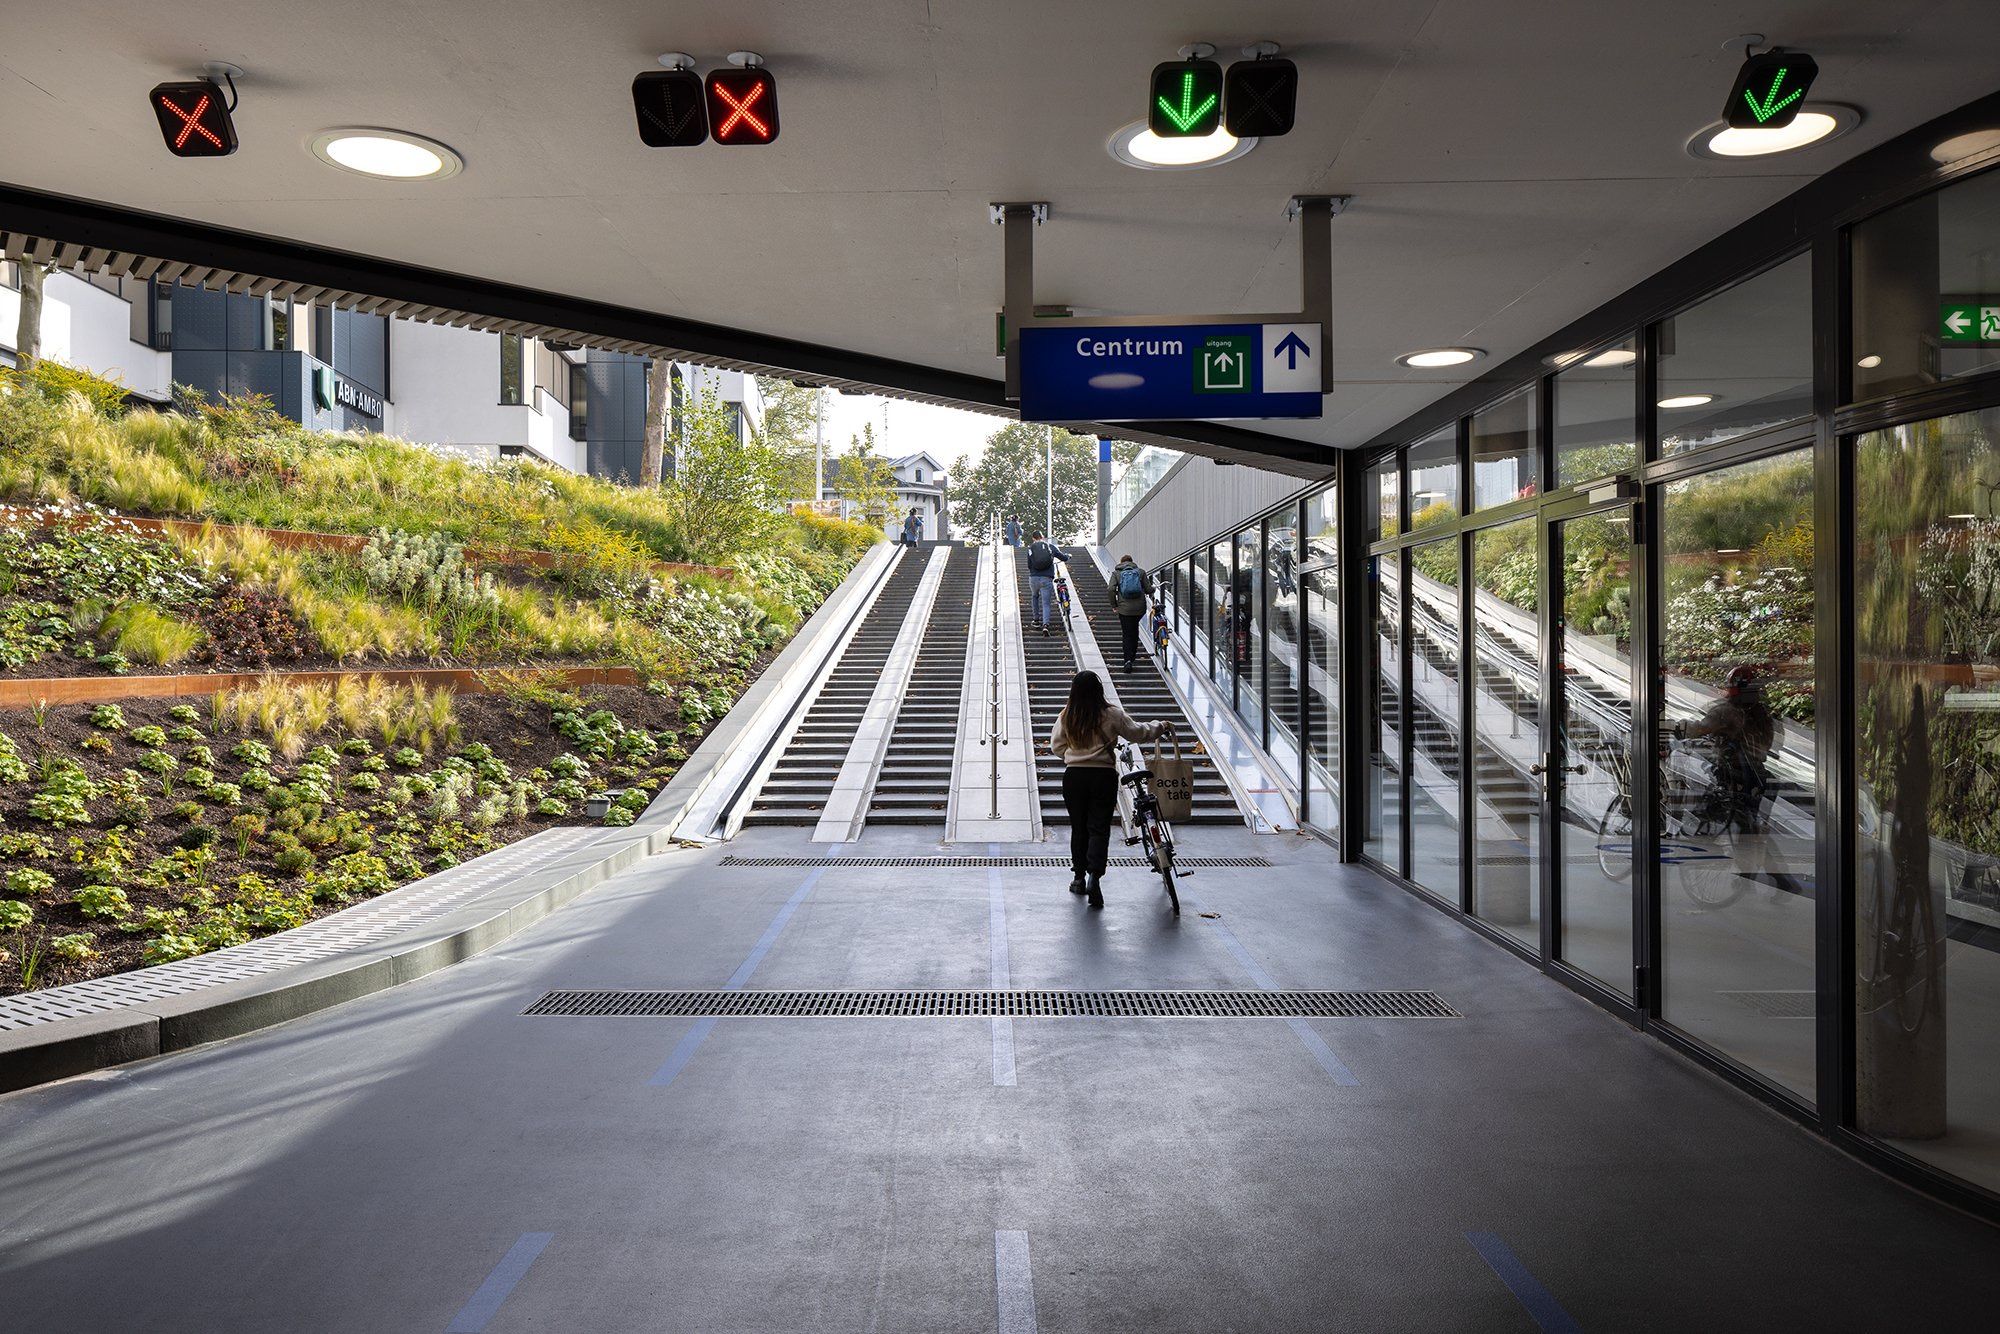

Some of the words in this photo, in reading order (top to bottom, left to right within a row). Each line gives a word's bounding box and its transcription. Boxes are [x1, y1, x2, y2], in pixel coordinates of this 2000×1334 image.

[1076, 337, 1183, 356] Centrum
[1156, 778, 1179, 788] ace
[1181, 777, 1189, 788] &
[1167, 789, 1190, 800] tate
